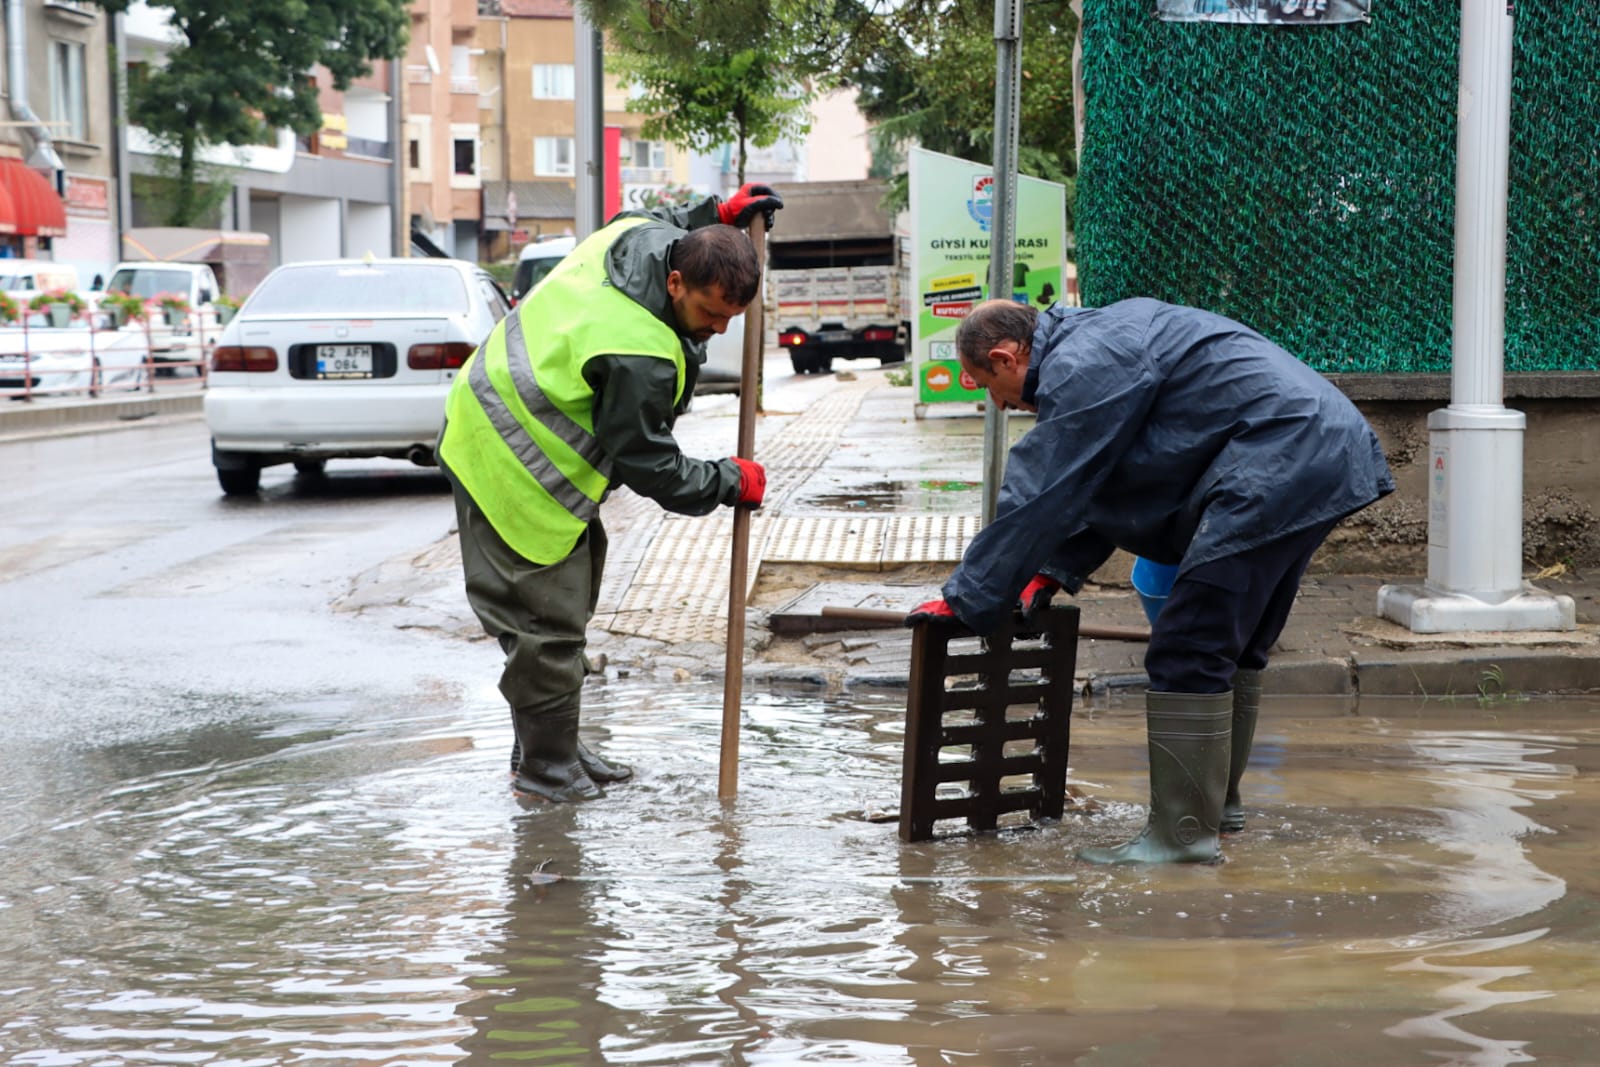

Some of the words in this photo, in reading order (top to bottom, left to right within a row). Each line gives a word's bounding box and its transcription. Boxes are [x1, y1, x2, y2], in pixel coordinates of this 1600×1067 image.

[931, 237, 966, 249] GİYSİ
[970, 238, 1048, 249] KURASI
[320, 347, 336, 358] 42
[345, 347, 370, 357] AFH
[334, 359, 358, 370] 084
